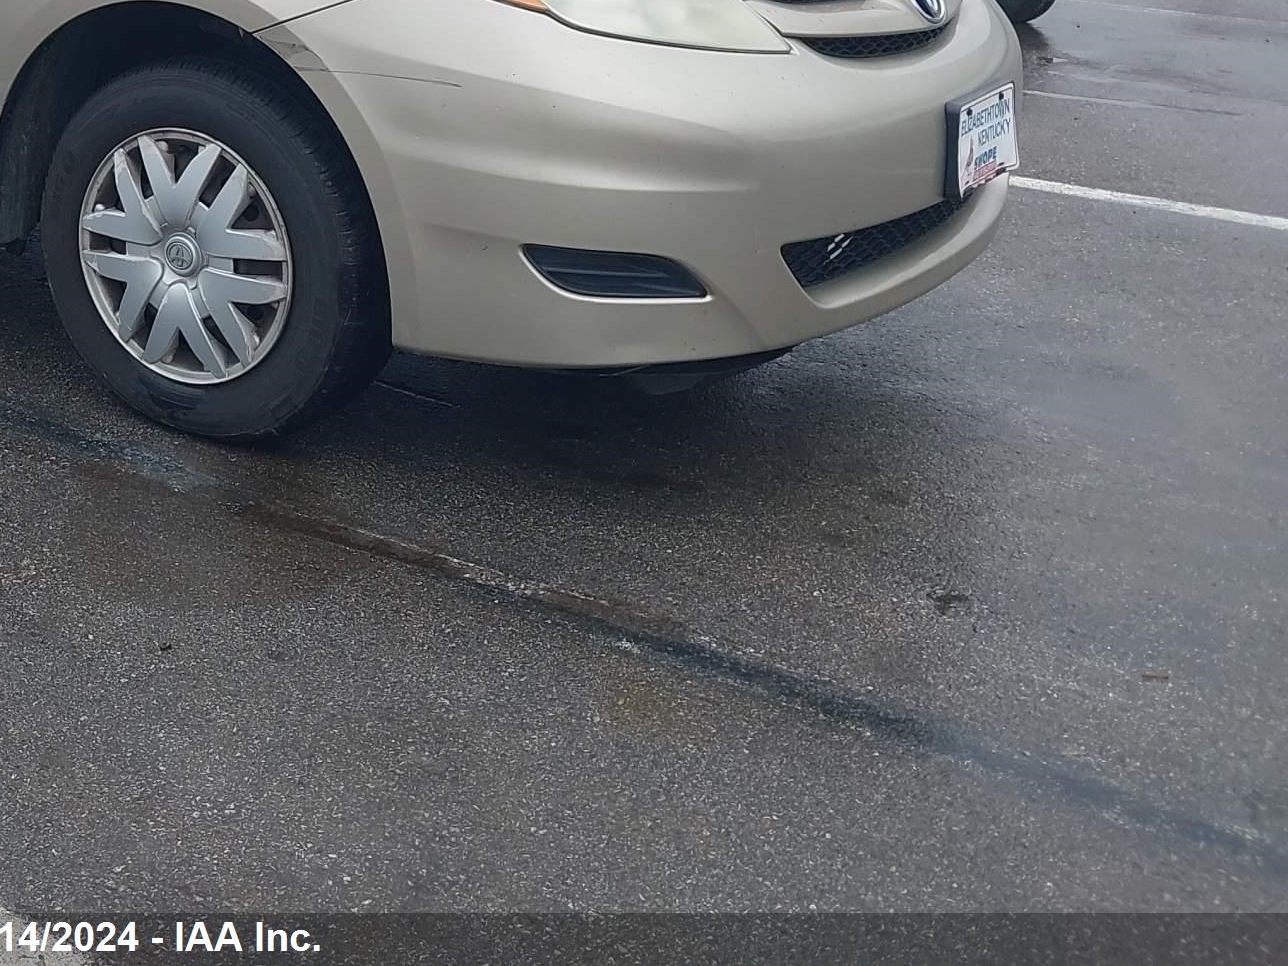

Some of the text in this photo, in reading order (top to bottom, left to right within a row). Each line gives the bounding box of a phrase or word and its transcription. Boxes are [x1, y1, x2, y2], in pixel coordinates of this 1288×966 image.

[961, 97, 1010, 137] ELIZABETHTOWN
[977, 117, 1011, 147] KENTUCKY
[974, 145, 997, 170] SWOPE
